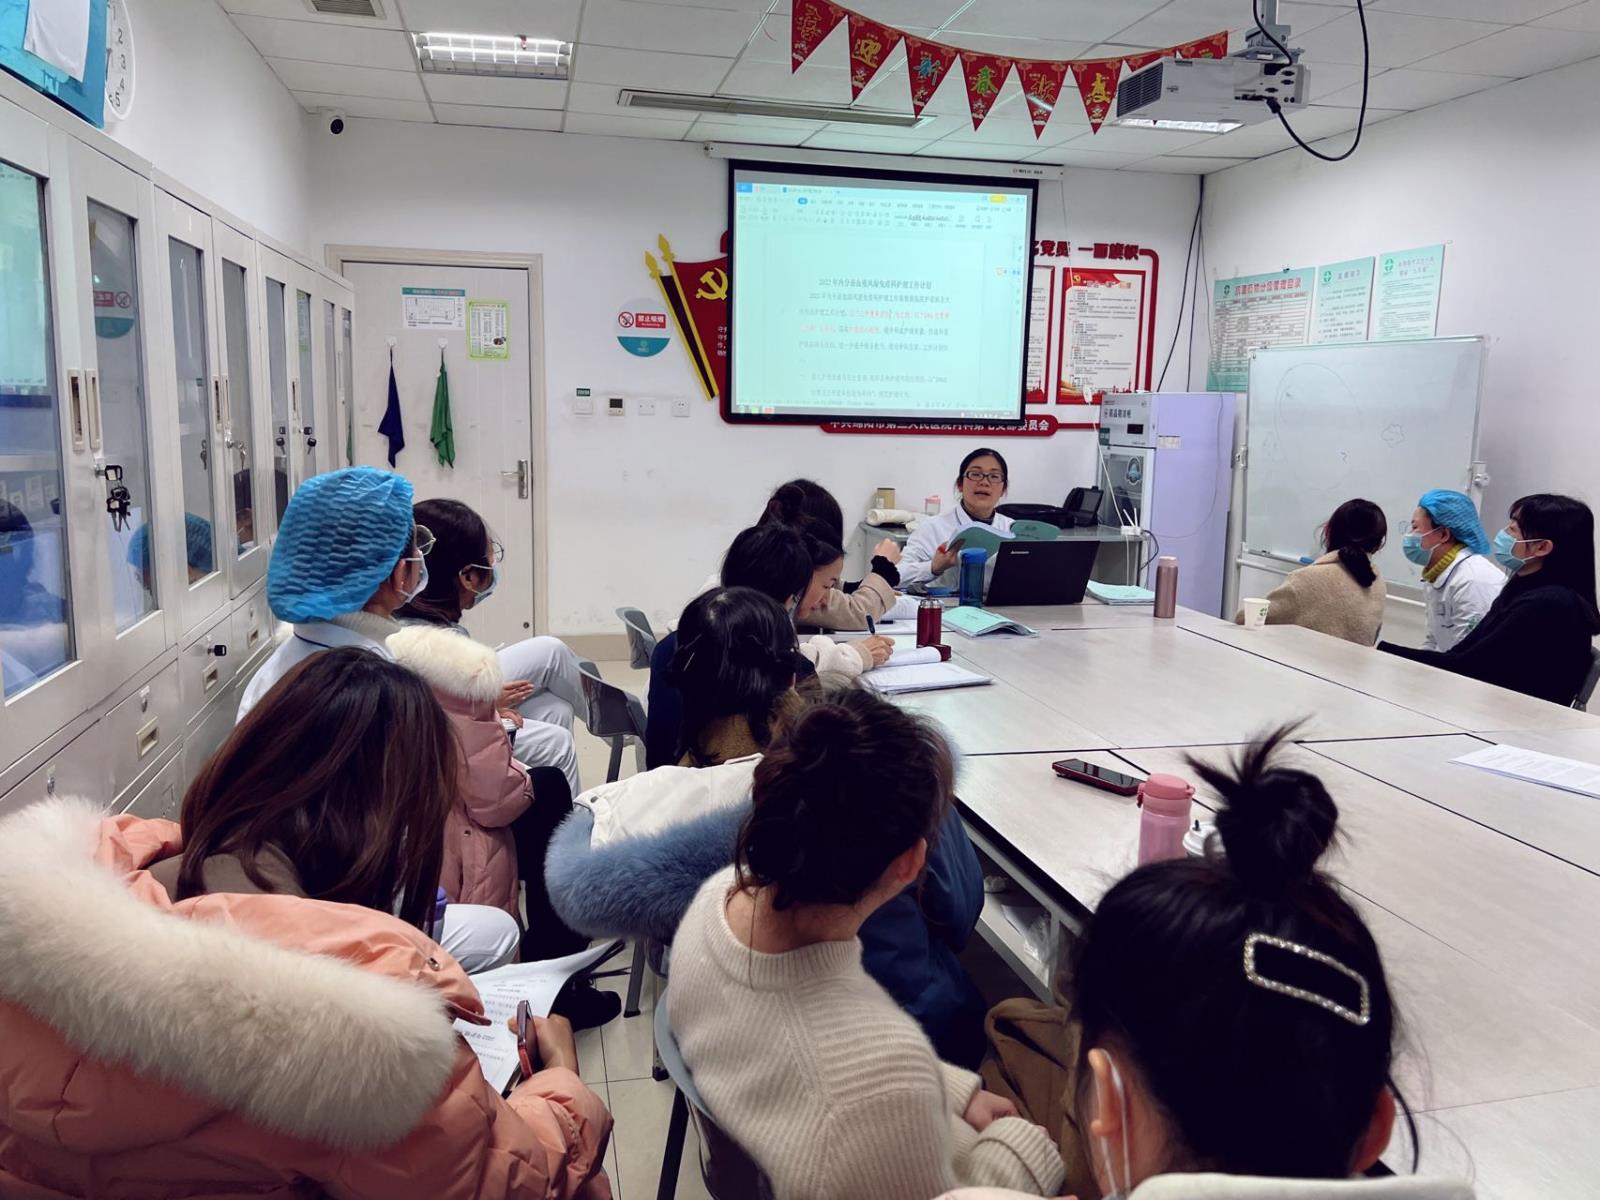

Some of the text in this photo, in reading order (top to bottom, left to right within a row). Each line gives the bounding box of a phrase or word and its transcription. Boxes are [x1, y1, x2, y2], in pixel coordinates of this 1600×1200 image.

[117, 28, 123, 44] 2
[852, 37, 882, 68] 迎
[913, 55, 942, 86] 新
[971, 64, 998, 96] 春
[1078, 243, 1139, 260] 一面旗帜
[637, 315, 664, 323] 禁止吸烟
